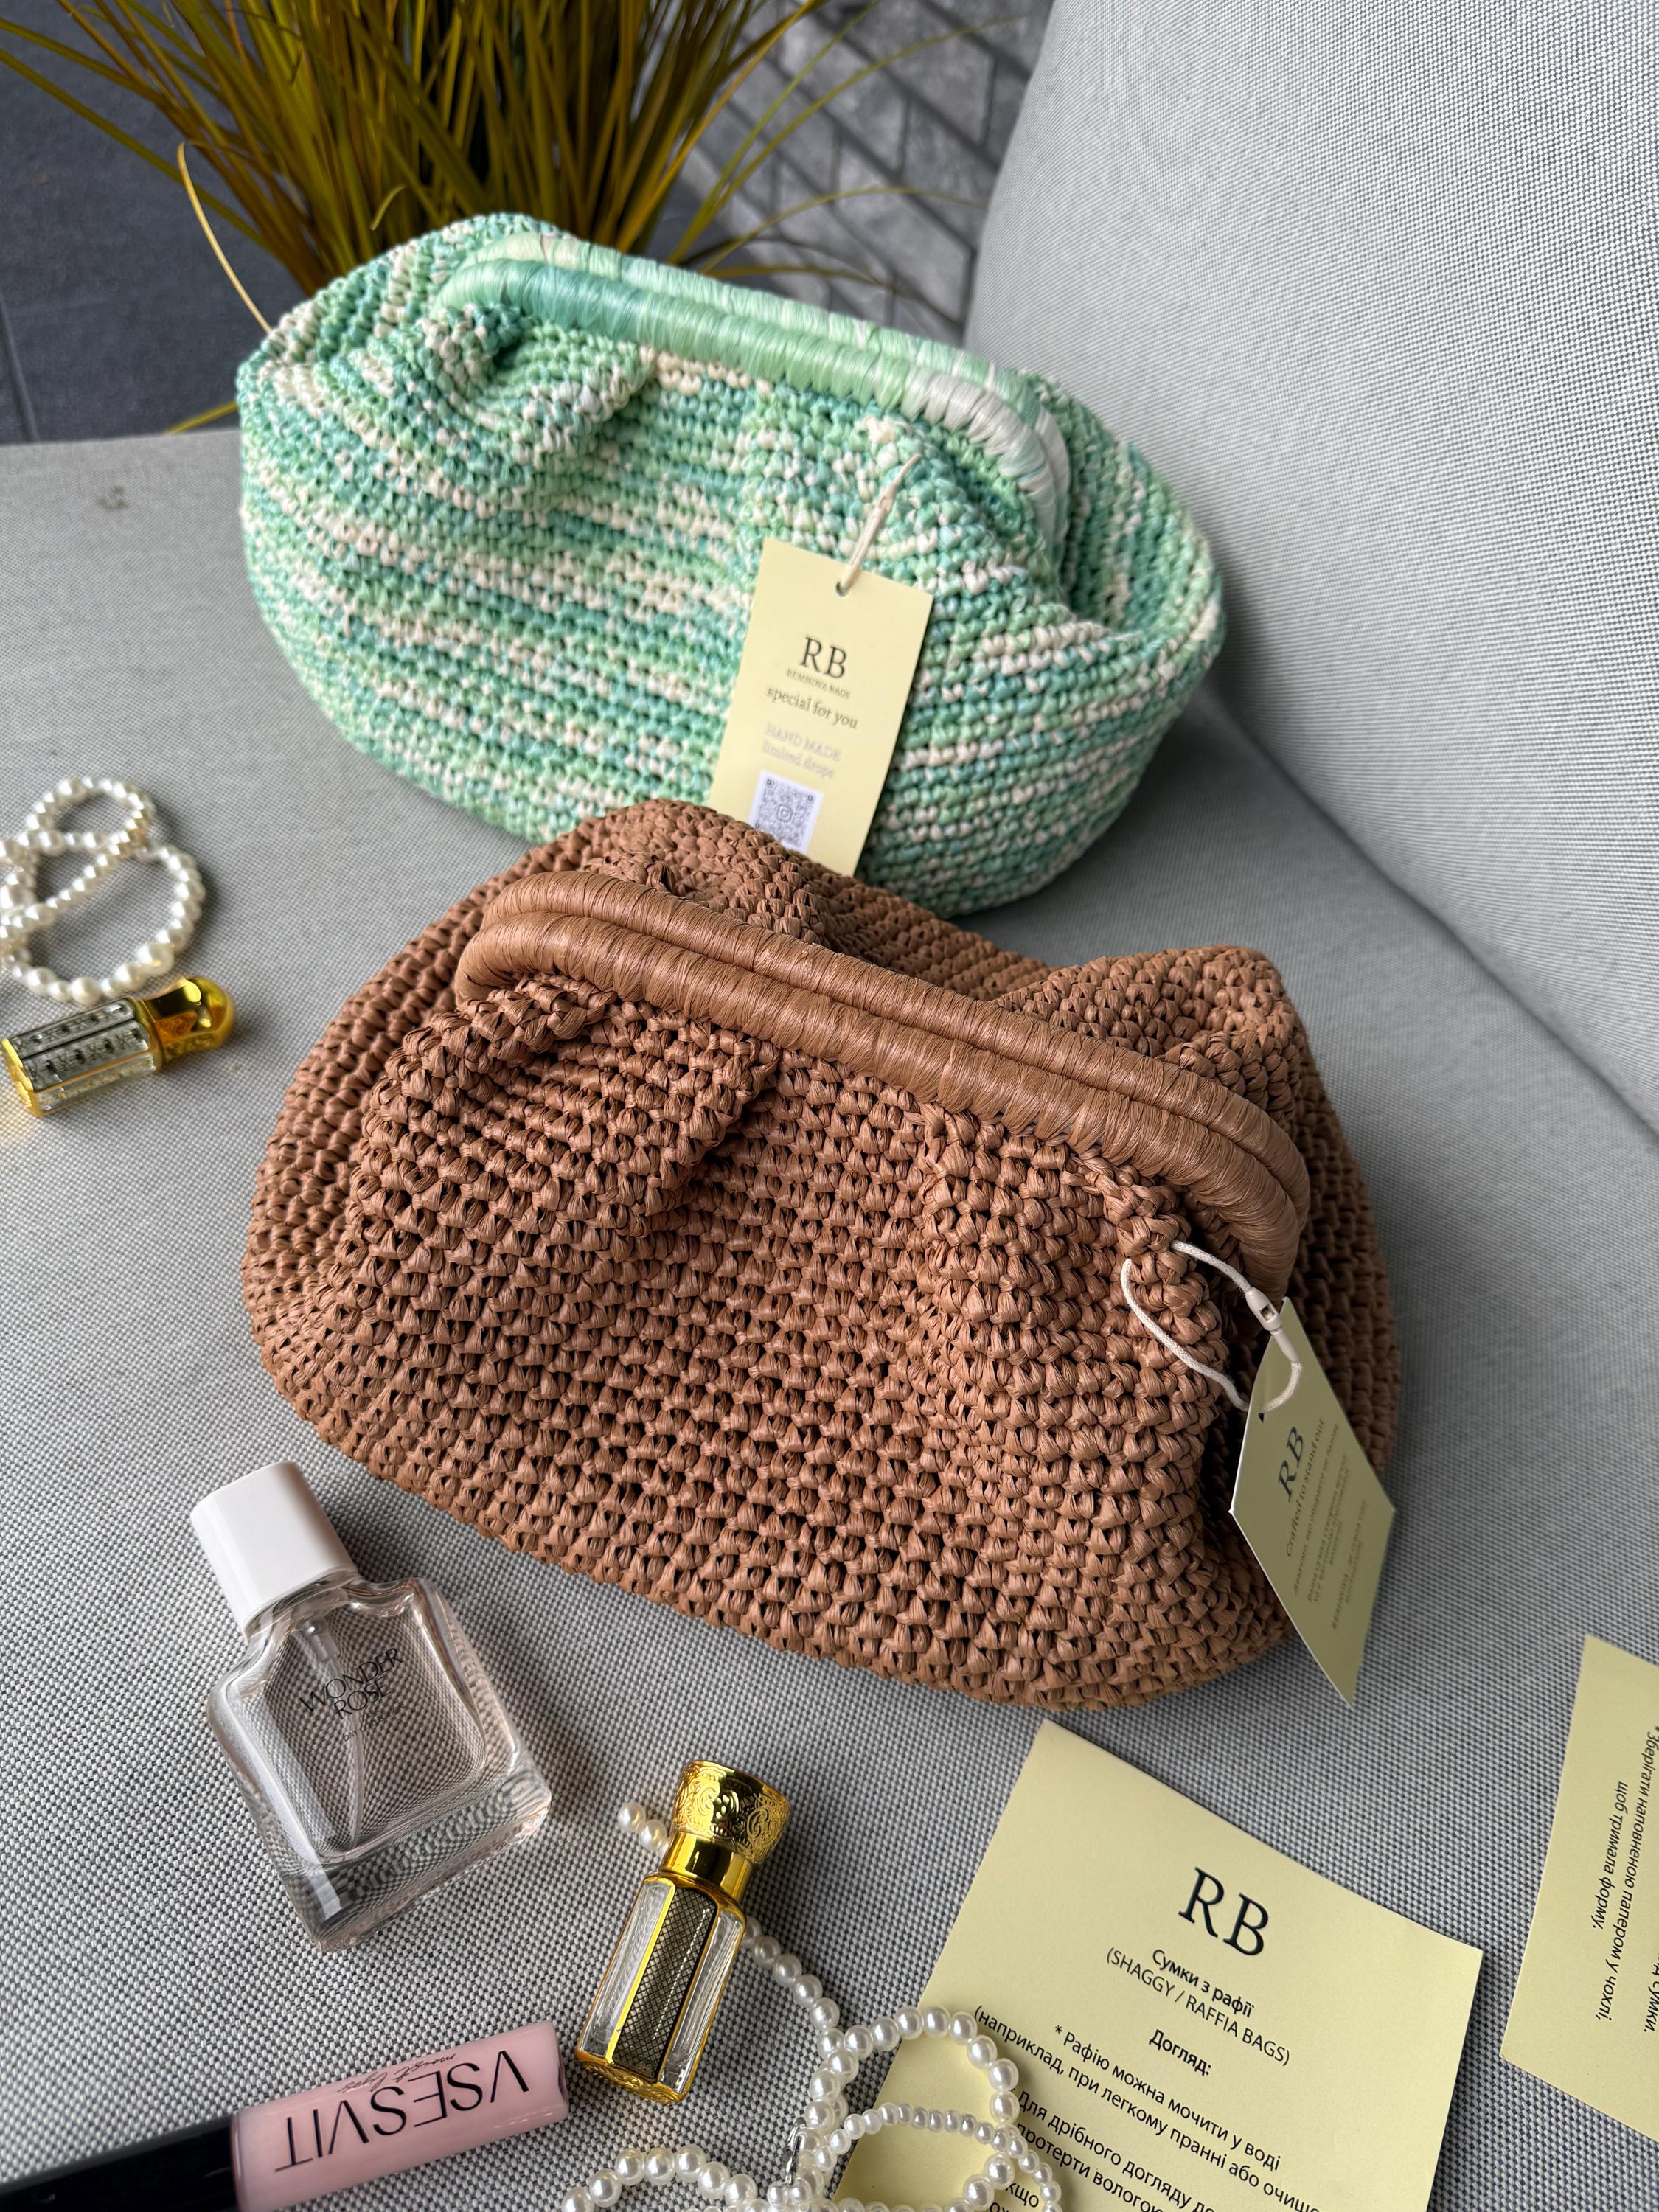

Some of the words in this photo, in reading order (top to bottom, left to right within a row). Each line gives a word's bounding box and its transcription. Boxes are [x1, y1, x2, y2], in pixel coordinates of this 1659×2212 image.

[799, 637, 846, 679] RB
[766, 686, 812, 712] special
[813, 700, 833, 720] for
[832, 712, 858, 729] you
[762, 739, 801, 767] limited
[803, 756, 835, 779] drops
[766, 724, 802, 748] HAND
[804, 737, 842, 762] MADE
[1278, 1427, 1304, 1503] RB
[1286, 1500, 1302, 1557] Crafted
[1304, 1441, 1318, 1484] stand
[1315, 1417, 1324, 1443] out
[299, 1648, 403, 1712] WONDER
[334, 1675, 392, 1719] ROSE
[1615, 1781, 1629, 1814] щоб
[1604, 1814, 1623, 1874] тримала
[1624, 1798, 1648, 1888] наповненою
[1178, 1867, 1269, 1956] RB
[1590, 1877, 1615, 1930] форму.
[1611, 1890, 1632, 1960] папером
[1107, 1947, 1175, 1997] (SHAGGY
[1186, 1995, 1238, 2038] RAFFIA
[1242, 2028, 1290, 2066] BAGS)
[1152, 1949, 1199, 1987] Сумки
[1201, 1980, 1211, 1993] з
[1211, 1987, 1255, 2018] рафії
[1595, 1975, 1617, 2021] чохлі,
[337, 2070, 389, 2093] lips
[392, 2053, 456, 2084] moist
[1149, 2029, 1211, 2076] Догляд:
[275, 2050, 530, 2171] VSESVIT
[974, 2006, 1064, 2075] (наприклад,
[1068, 2066, 1100, 2094] при
[1101, 2088, 1168, 2136] легкому
[1170, 2128, 1226, 2169] пранні
[1229, 2163, 1259, 2188] або
[1064, 2031, 1110, 2070] Рафію
[1112, 2065, 1165, 2105] можна
[1168, 2098, 1228, 2142] мочити
[1230, 2135, 1242, 2151] у
[1245, 2142, 1281, 2171] воді
[1018, 2090, 1047, 2121] Для
[1048, 2115, 1121, 2166] дрібного
[1122, 2161, 1192, 2209] догляду
[1018, 2123, 1091, 2177] протерти
